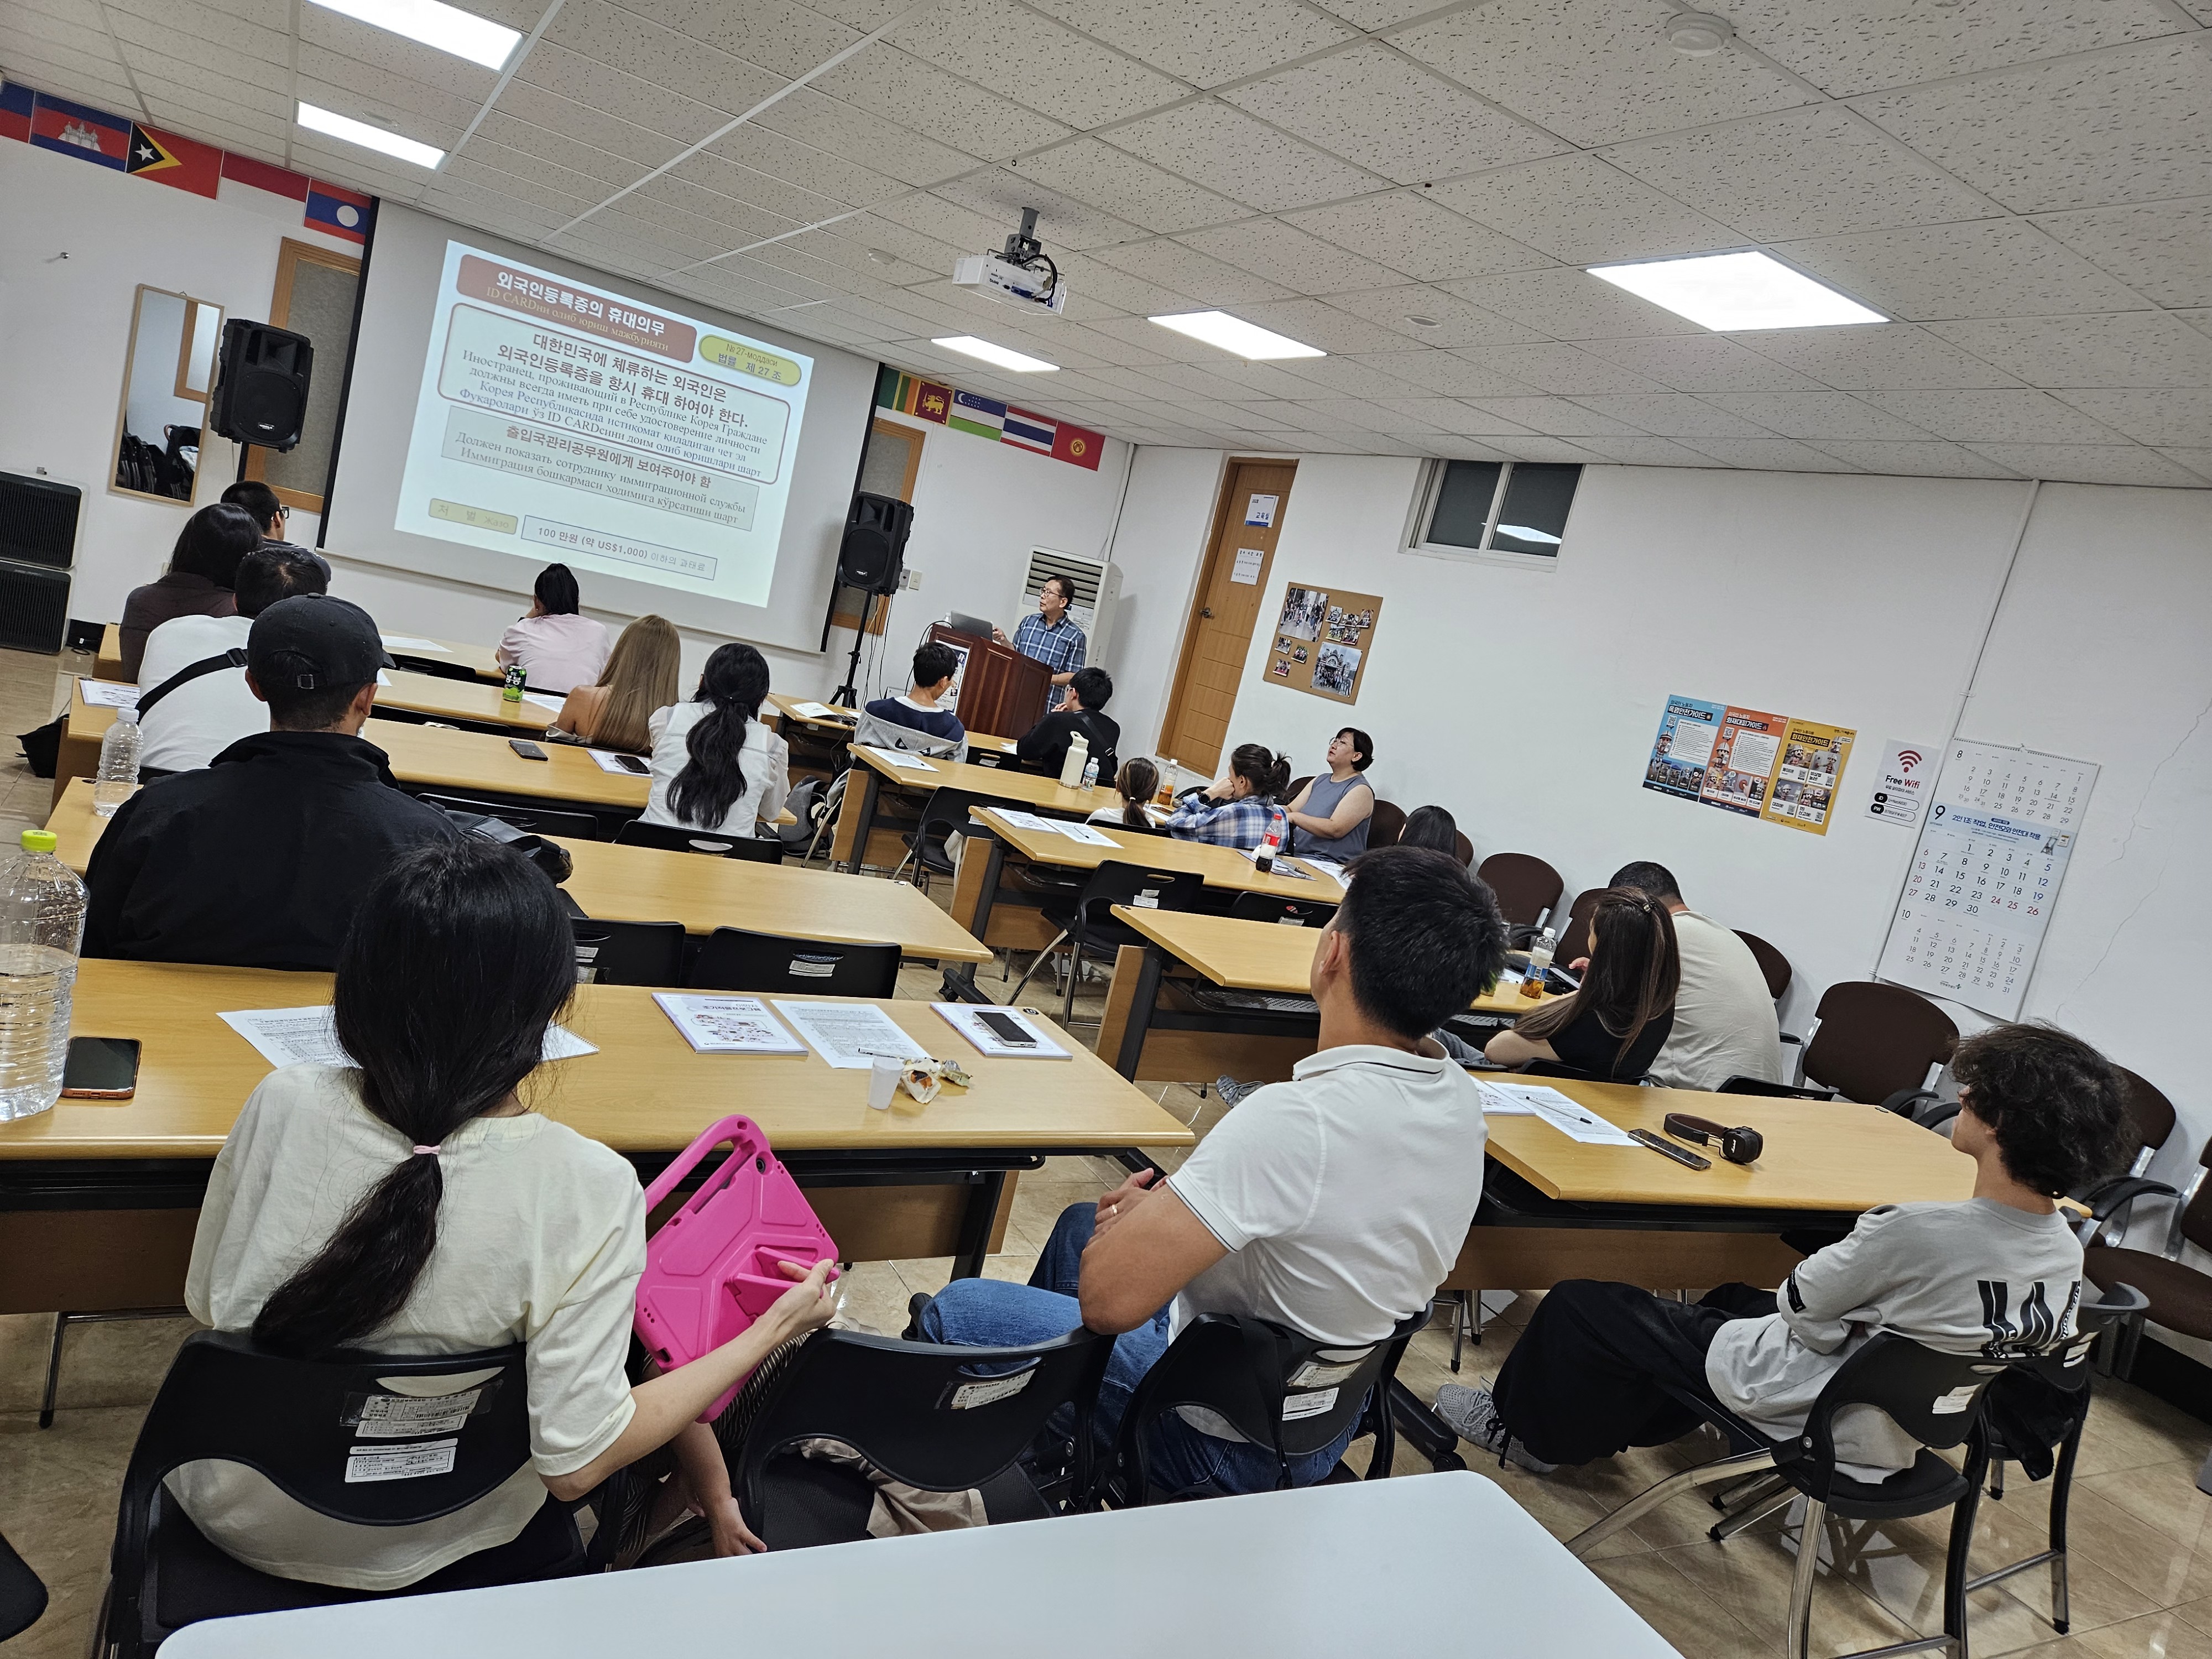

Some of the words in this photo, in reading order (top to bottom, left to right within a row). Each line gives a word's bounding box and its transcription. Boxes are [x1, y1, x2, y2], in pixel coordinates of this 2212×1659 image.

[487, 286, 500, 299] ID
[503, 292, 549, 315] CARDни
[552, 310, 576, 322] олиб
[579, 316, 608, 332] юриш
[611, 326, 668, 352] мажбурияти
[497, 272, 603, 319] 외국인등록증의
[608, 307, 664, 336] 휴대의무
[533, 333, 607, 368] 대한민국에
[612, 357, 668, 385] 체류하는
[672, 375, 727, 403] 외국인은
[737, 347, 778, 367] 27-моддаси
[745, 362, 755, 373] 제
[758, 367, 770, 376] 27
[771, 370, 781, 380] 조
[463, 349, 534, 380] Иностранец,
[539, 374, 617, 401] проживающий
[629, 397, 687, 421] Республике
[690, 415, 719, 431] Корея
[722, 424, 768, 445] Граждане
[498, 344, 603, 387] 외국인등록증을
[608, 375, 637, 396] 항시
[641, 386, 669, 406] 휴대
[674, 395, 714, 419] 하여야
[719, 408, 748, 427] 한다.
[469, 368, 516, 387] должны
[520, 382, 554, 398] всегда
[557, 391, 589, 406] иметь
[593, 400, 612, 414] при
[615, 407, 638, 420] себе
[639, 416, 713, 441] удостоверение
[716, 436, 761, 455] личности
[480, 380, 513, 398] Корея
[517, 391, 604, 423] Республикасида
[718, 448, 732, 458] чет
[736, 453, 746, 462] эл
[460, 388, 529, 415] Фукаролари
[531, 406, 545, 419] ўз
[547, 411, 561, 422] ID
[565, 416, 625, 441] CARDсини
[627, 436, 654, 448] доим
[656, 444, 681, 456] олиб
[684, 450, 735, 470] юришлари
[737, 466, 761, 478] шарт
[455, 432, 502, 451] Должен
[505, 446, 552, 464] показать
[556, 459, 616, 481] сотруднику
[620, 474, 707, 502] иммиграционной
[710, 497, 745, 513] службы
[507, 425, 634, 468] 출입국관리공무원에게
[637, 460, 696, 486] 보여주어야
[701, 477, 711, 488] 함
[461, 447, 533, 473] Иммиграция
[606, 486, 654, 503] ходимига
[658, 497, 711, 517] кўрсатиши
[714, 512, 738, 524] шарт
[484, 516, 509, 528] Жазо
[539, 528, 556, 538] 100
[560, 532, 578, 544] 만원
[582, 536, 594, 547] (약
[598, 540, 648, 559] US$1,000)
[651, 553, 676, 565] 이하의
[680, 559, 706, 571] 과태료
[1668, 706, 1707, 719] 폭염안전가이드
[1726, 717, 1763, 730] 화재대피가이드
[1792, 733, 1829, 747] 화재안전가이드
[1886, 775, 1902, 785] Free
[1905, 779, 1920, 789] Wifi
[1935, 805, 1946, 820] 9
[1988, 823, 2012, 833] 안전모와
[2012, 829, 2028, 837] 안전대
[1935, 866, 1944, 874] 14
[1955, 871, 1965, 879] 15
[1977, 877, 1986, 885] 16
[2013, 886, 2022, 895] 18
[2033, 891, 2043, 900] 19
[2001, 868, 2009, 876] 10
[2038, 878, 2048, 886] 12
[1901, 910, 1911, 918] 10
[1925, 893, 1936, 902] 28
[1945, 899, 1957, 907] 29
[1967, 905, 1978, 913] 30
[1950, 885, 1961, 894] 22
[1971, 890, 1982, 899] 23
[1991, 896, 2000, 904] 24
[2007, 901, 2018, 909] 25
[2027, 906, 2039, 915] 26
